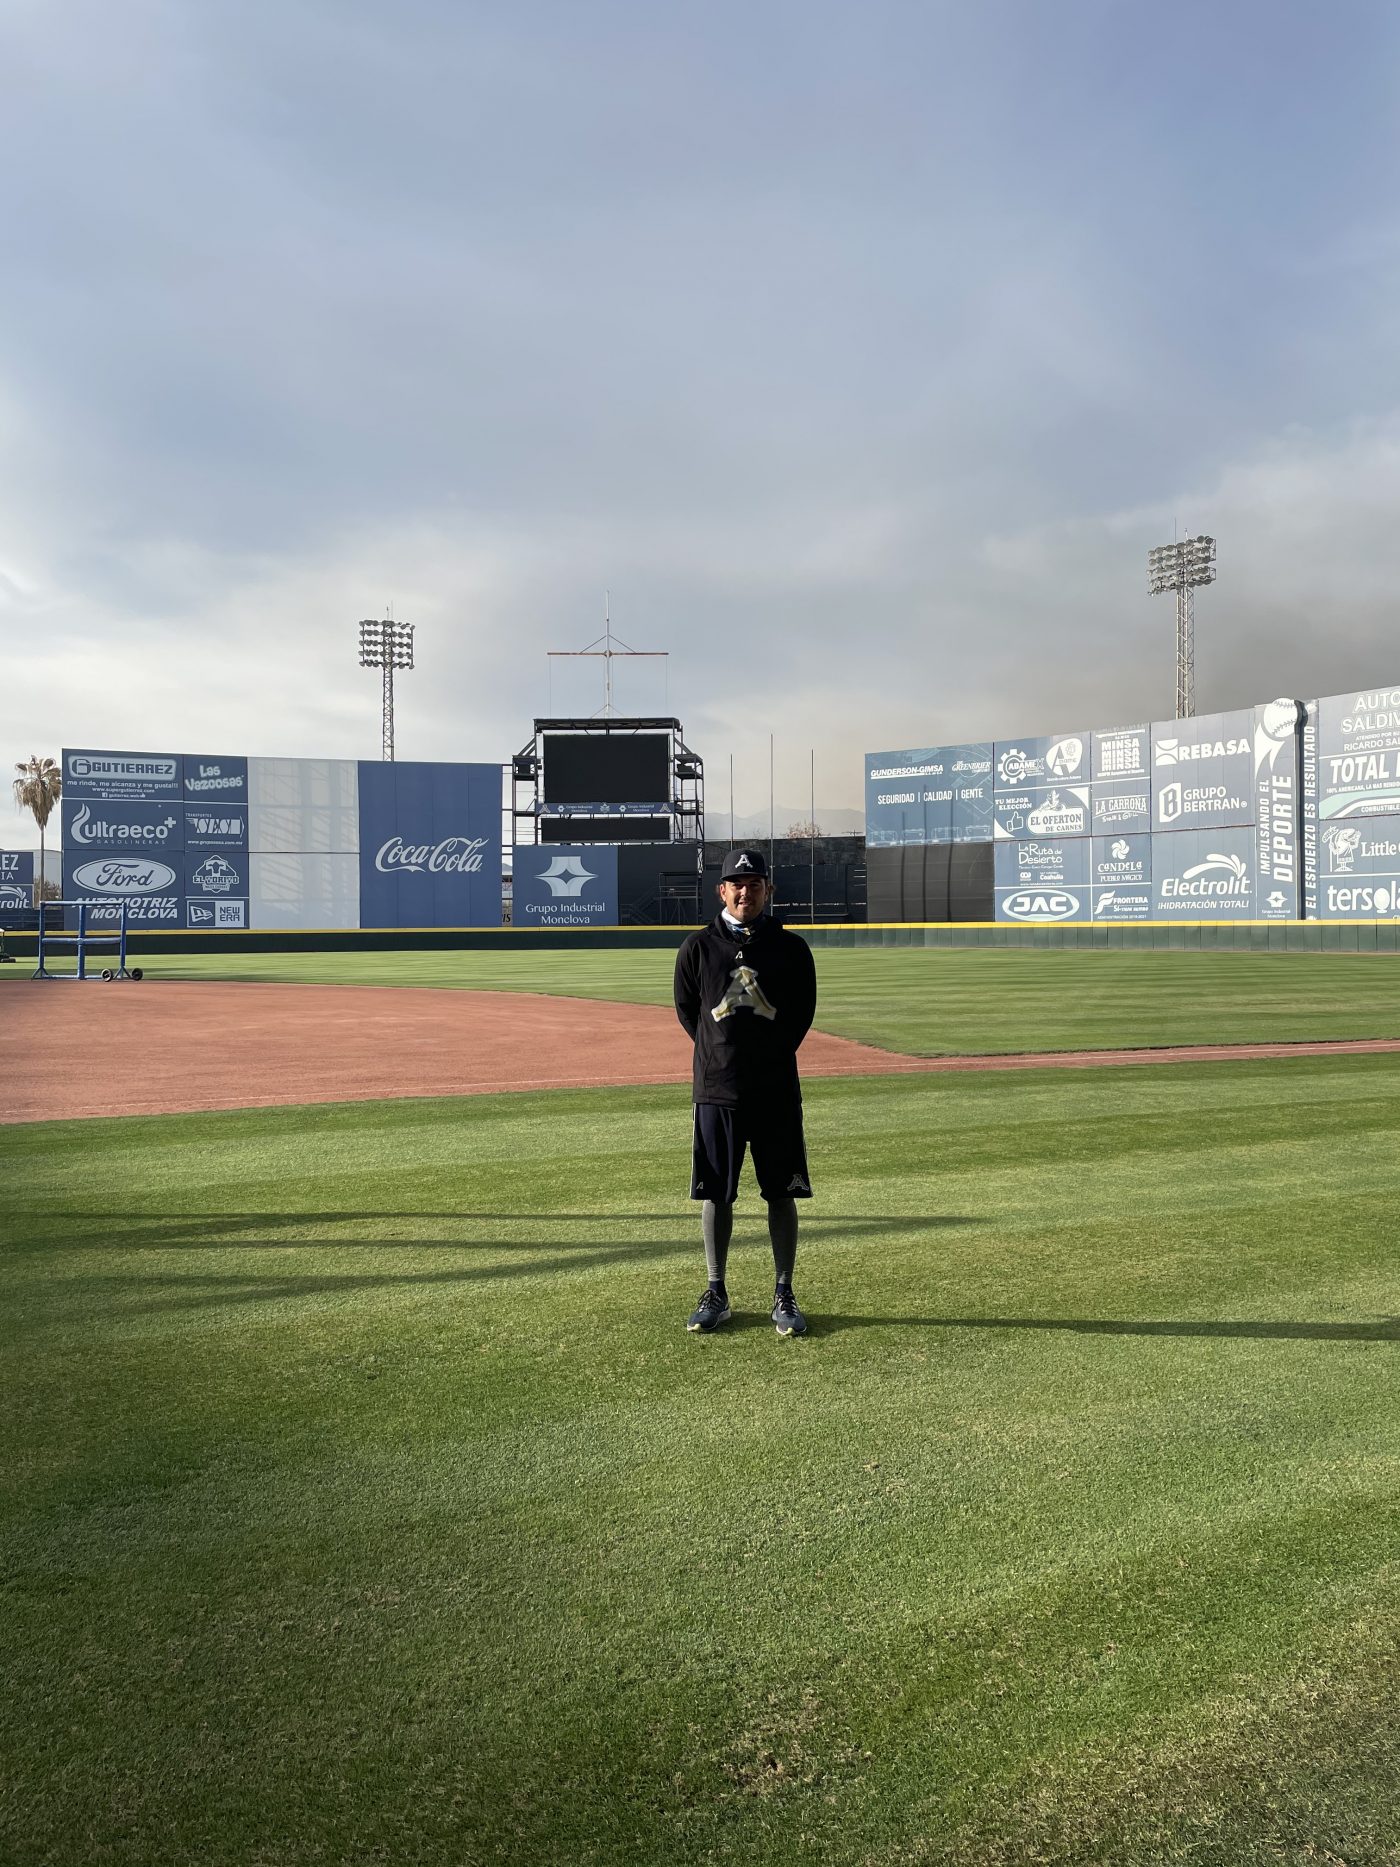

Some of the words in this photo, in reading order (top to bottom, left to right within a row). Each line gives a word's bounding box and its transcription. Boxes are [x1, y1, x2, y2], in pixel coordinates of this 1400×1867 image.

[1102, 738, 1140, 751] MINSA
[1179, 738, 1251, 760] REBASA
[1344, 739, 1383, 751] RICARDO
[92, 762, 172, 774] GUTIERREZ
[1304, 726, 1316, 797] RESULTADO
[200, 765, 220, 777] Las
[870, 765, 944, 777] GUNDERSON-GIMSA
[1330, 754, 1390, 784] TOTAL
[1184, 786, 1226, 800] GRUPO
[1259, 780, 1269, 792] EL
[878, 793, 914, 805] SEGURIDAD
[924, 790, 952, 801] CALIDAD
[961, 788, 983, 799] GENTE
[1095, 801, 1106, 815] LA
[1184, 798, 1240, 812] BERTRAN
[1304, 803, 1316, 818] ES
[1031, 816, 1040, 825] EL
[1042, 814, 1082, 825] OFERTON
[1272, 776, 1294, 882] DEPORTE
[1260, 799, 1270, 874] IMPULSANDO
[375, 837, 489, 872] Coca-Cola
[1019, 843, 1028, 851] La
[1029, 844, 1053, 855] Ruta
[1361, 840, 1397, 857] Little
[0, 854, 18, 870] EZ
[1019, 852, 1062, 864] Desierto
[1304, 824, 1316, 889] ESFUERZO
[96, 863, 155, 886] Ford
[1161, 876, 1251, 896] Electrolit
[0, 898, 30, 908] rolit
[526, 904, 557, 914] Grupo
[561, 902, 606, 912] Industrial
[1014, 897, 1066, 912] JAC
[1220, 900, 1249, 908] TOTAL!
[1305, 895, 1316, 909] EL
[541, 915, 590, 924] Monclova
[711, 965, 777, 1022] A
